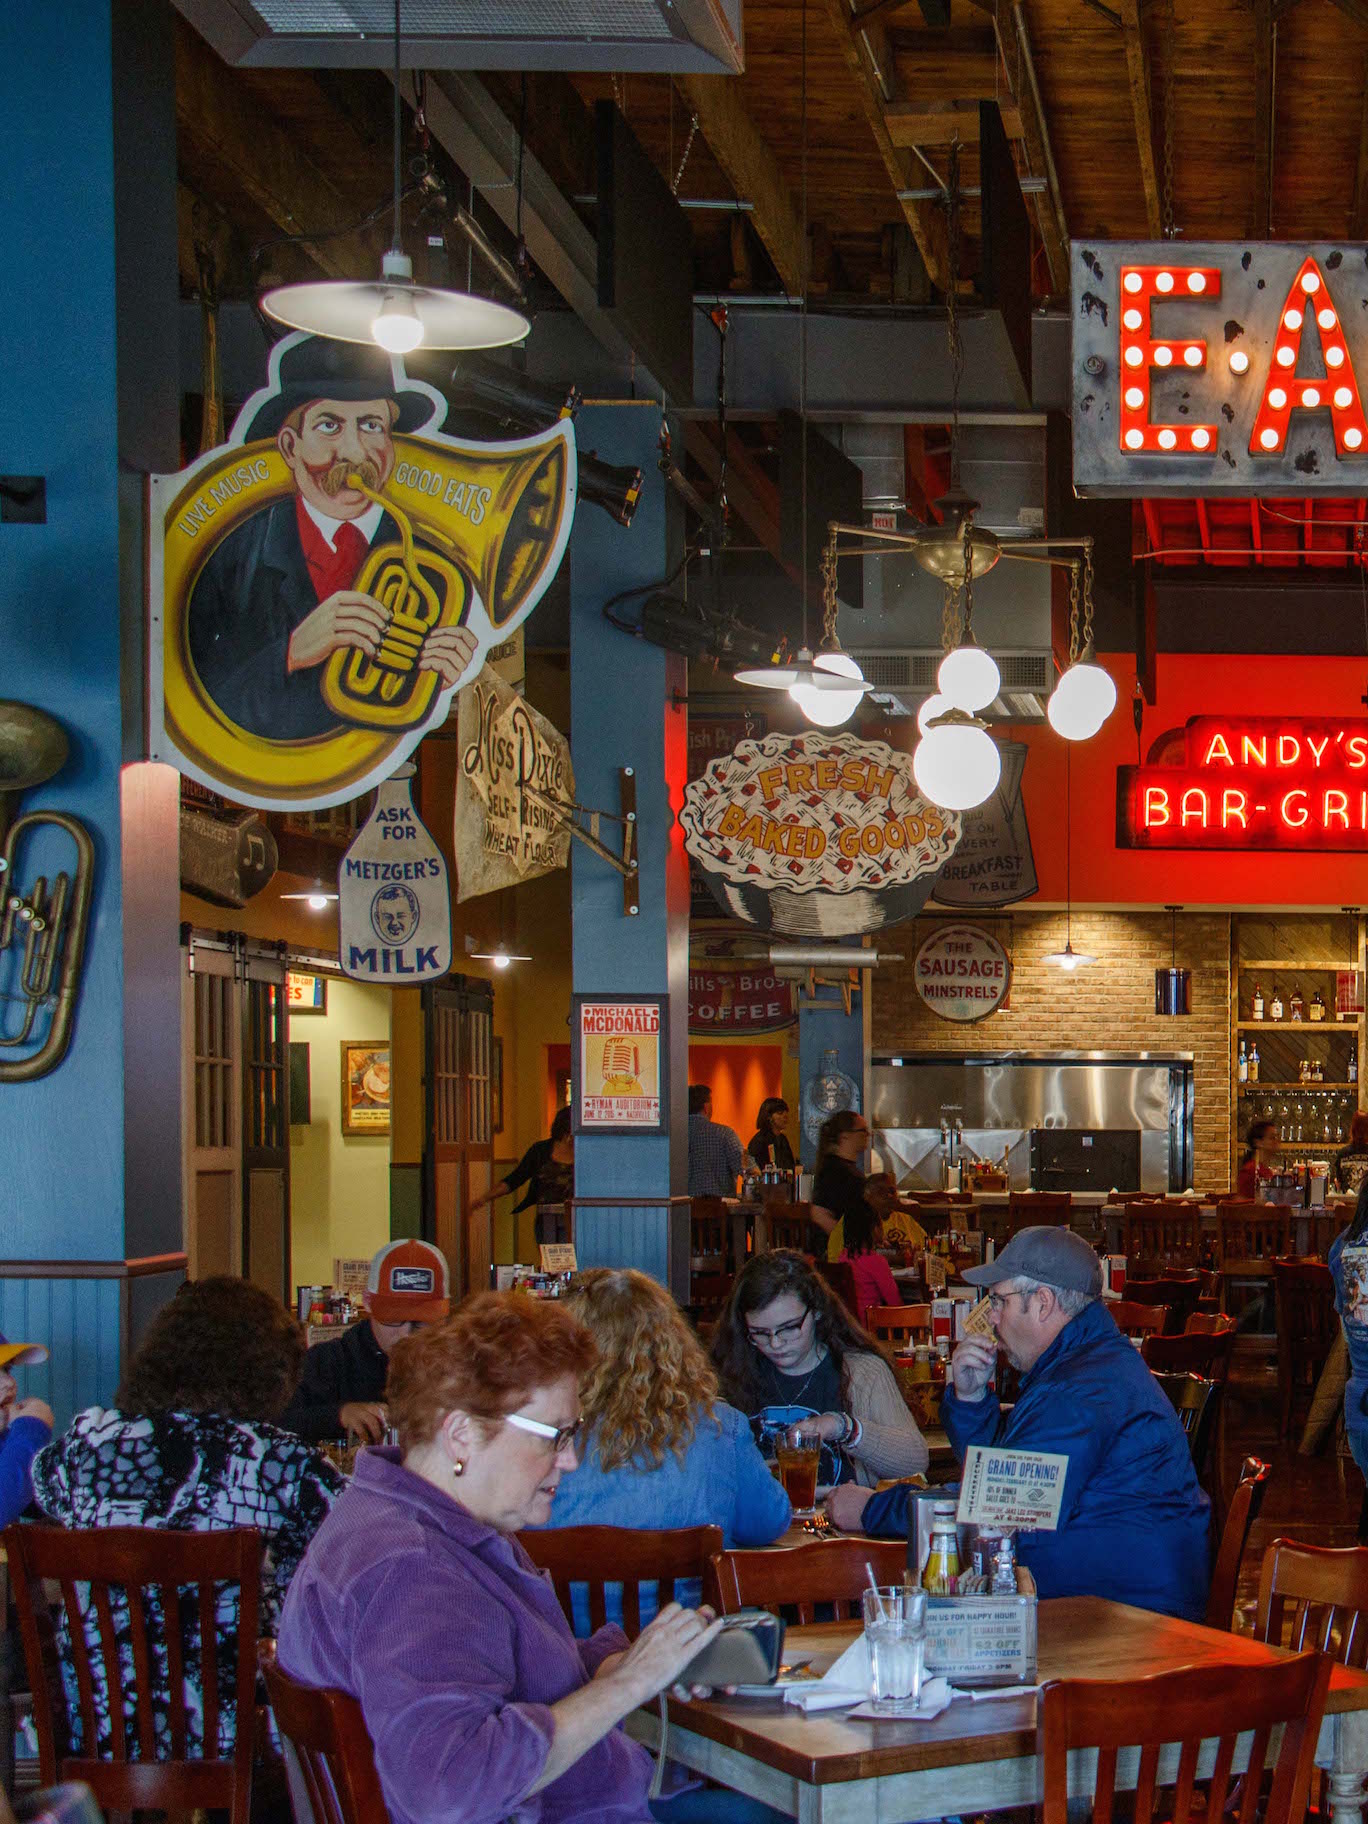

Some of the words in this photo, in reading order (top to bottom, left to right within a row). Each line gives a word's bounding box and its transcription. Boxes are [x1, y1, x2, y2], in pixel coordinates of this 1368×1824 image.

[178, 497, 216, 539] LIVE
[210, 459, 270, 507] MUSIC
[396, 461, 442, 496] GOOD
[443, 479, 492, 526] EATS
[464, 682, 514, 785] Miss
[513, 705, 562, 790] Dixie
[1205, 730, 1368, 768] ANDY'S
[757, 760, 896, 800] FRESH
[376, 807, 412, 823] ASK
[383, 826, 417, 841] FOR
[484, 820, 520, 857] WHEAT
[717, 802, 827, 859] BAKED
[838, 806, 945, 858] GOODS
[346, 857, 440, 881] METZGER'S
[942, 855, 1024, 880] BREAKFAST
[968, 880, 1018, 892] TABLE
[945, 942, 973, 953] THE
[350, 945, 441, 973] MILK
[919, 958, 1004, 978] SAUSAGE
[923, 984, 998, 999] MINSTRELS
[592, 1008, 650, 1017] MICHAEL
[583, 1016, 659, 1032] MCDONALD
[591, 1099, 613, 1110] RYMAN
[988, 1459, 1017, 1476] GRAND
[1019, 1461, 1059, 1481] OPENING!
[967, 1612, 992, 1620] HAPPY
[994, 1611, 1017, 1620] HOUR!
[974, 1649, 1022, 1657] APPETIZERS
[996, 1640, 1020, 1649] OFF
